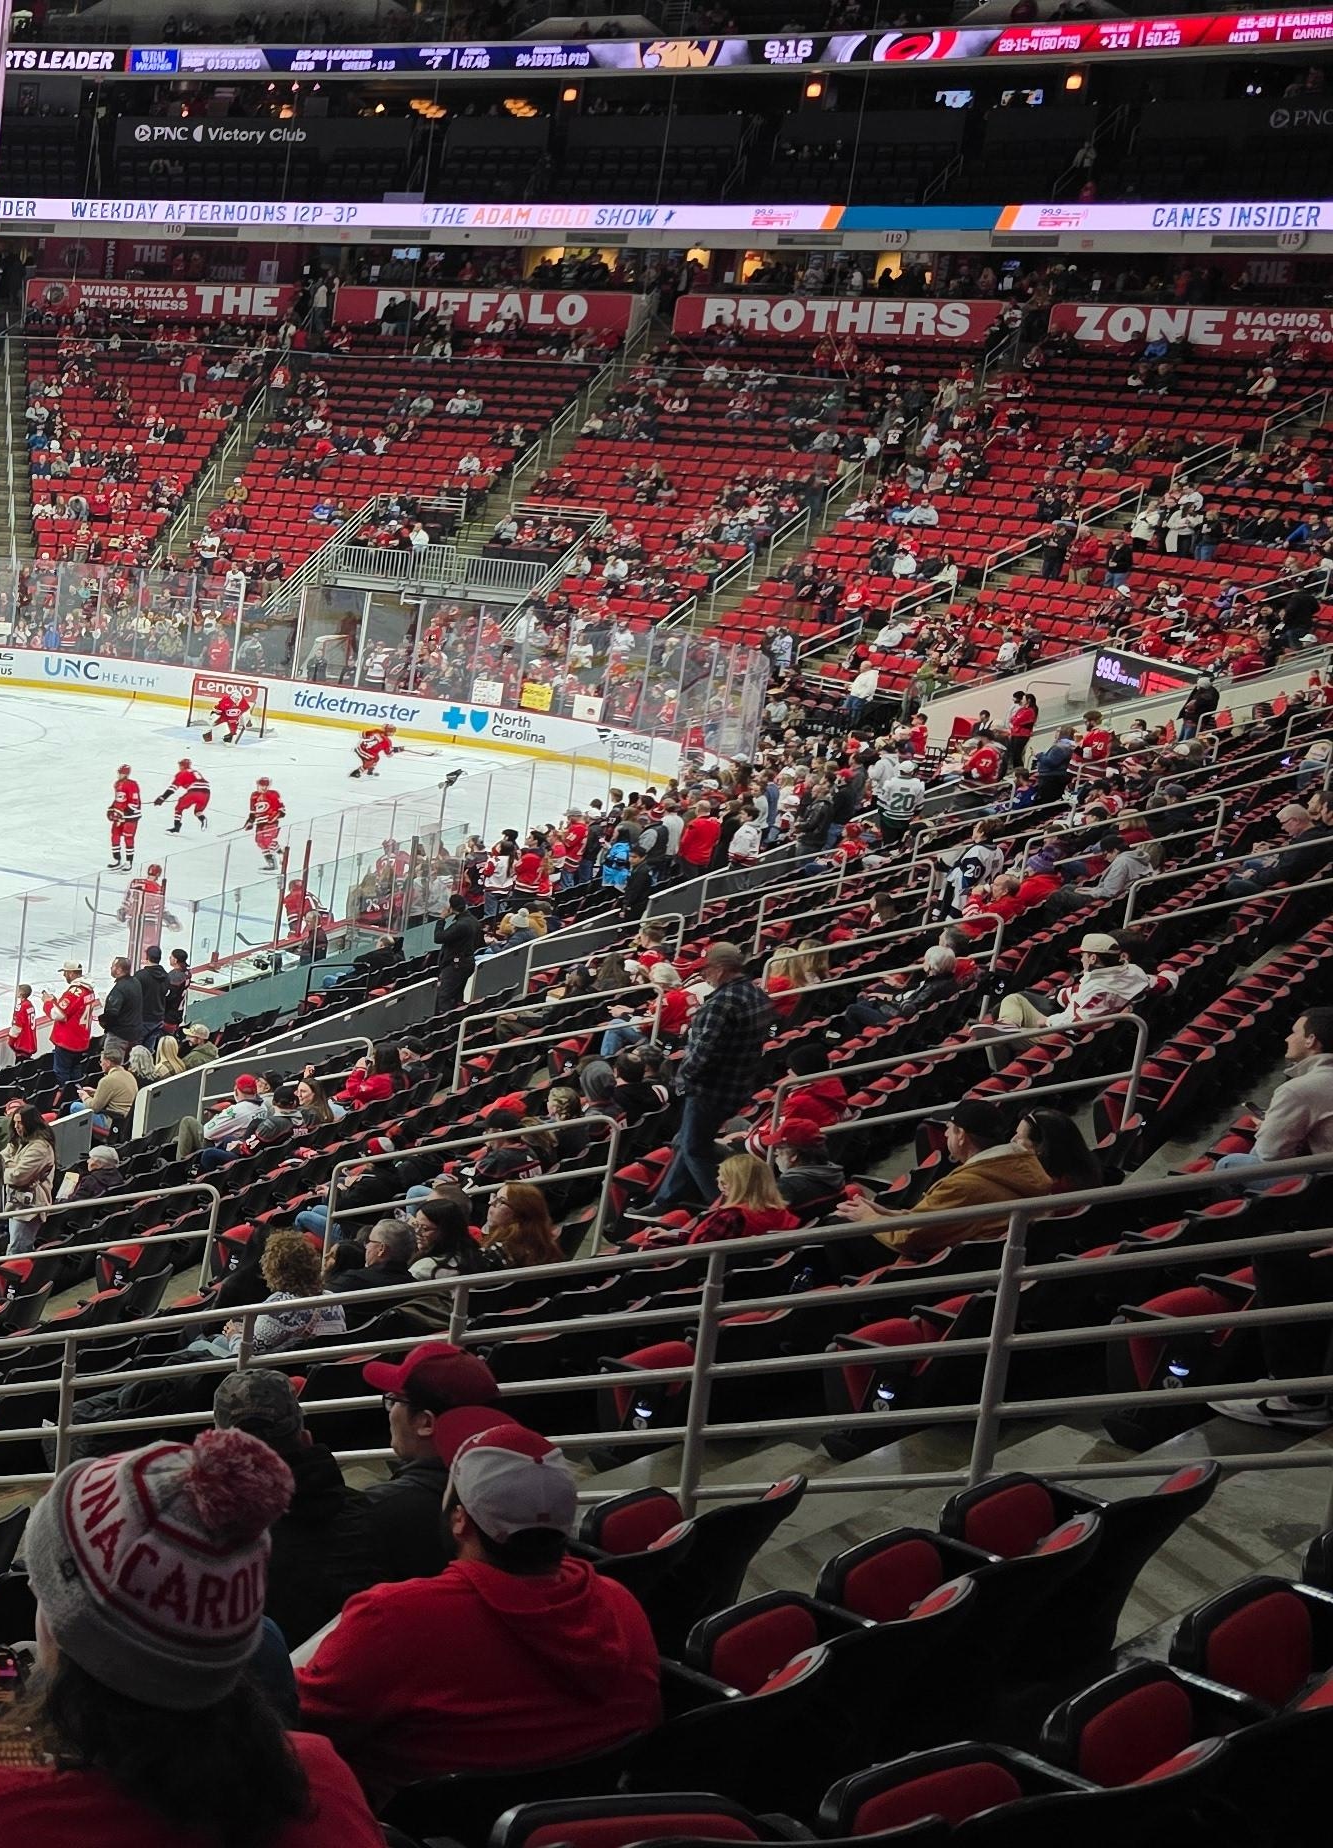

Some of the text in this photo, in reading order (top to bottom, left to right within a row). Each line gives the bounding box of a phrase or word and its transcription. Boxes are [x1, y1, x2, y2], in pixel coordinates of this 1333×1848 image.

[1277, 12, 1333, 27] LEADERS
[764, 39, 813, 58] 9:16
[1100, 33, 1130, 48] +14
[38, 51, 115, 69] LEADER
[153, 127, 307, 145] PNC Victory Club
[71, 201, 358, 224] WEEKDAY AFTERNOONS 12P-3P
[431, 208, 657, 226] THE ADAM GOLD SHOW
[1153, 206, 1321, 228] CANES INSIDER
[885, 233, 903, 245] 112
[1281, 232, 1301, 245] 113
[81, 285, 188, 299] WINGS, PIZZA &
[195, 286, 283, 317] THE
[702, 298, 972, 339] BROTHERS
[1074, 307, 1227, 346] ZONE
[1235, 312, 1324, 330] NACHOS,
[44, 656, 156, 687] UNC HEALTH
[1096, 656, 1120, 684] 99.9
[199, 680, 253, 698] Lenovo
[294, 689, 421, 724] ticketmaster
[493, 712, 531, 729] North
[492, 725, 546, 745] Carolina
[890, 793, 914, 811] 20
[965, 864, 981, 879] 20
